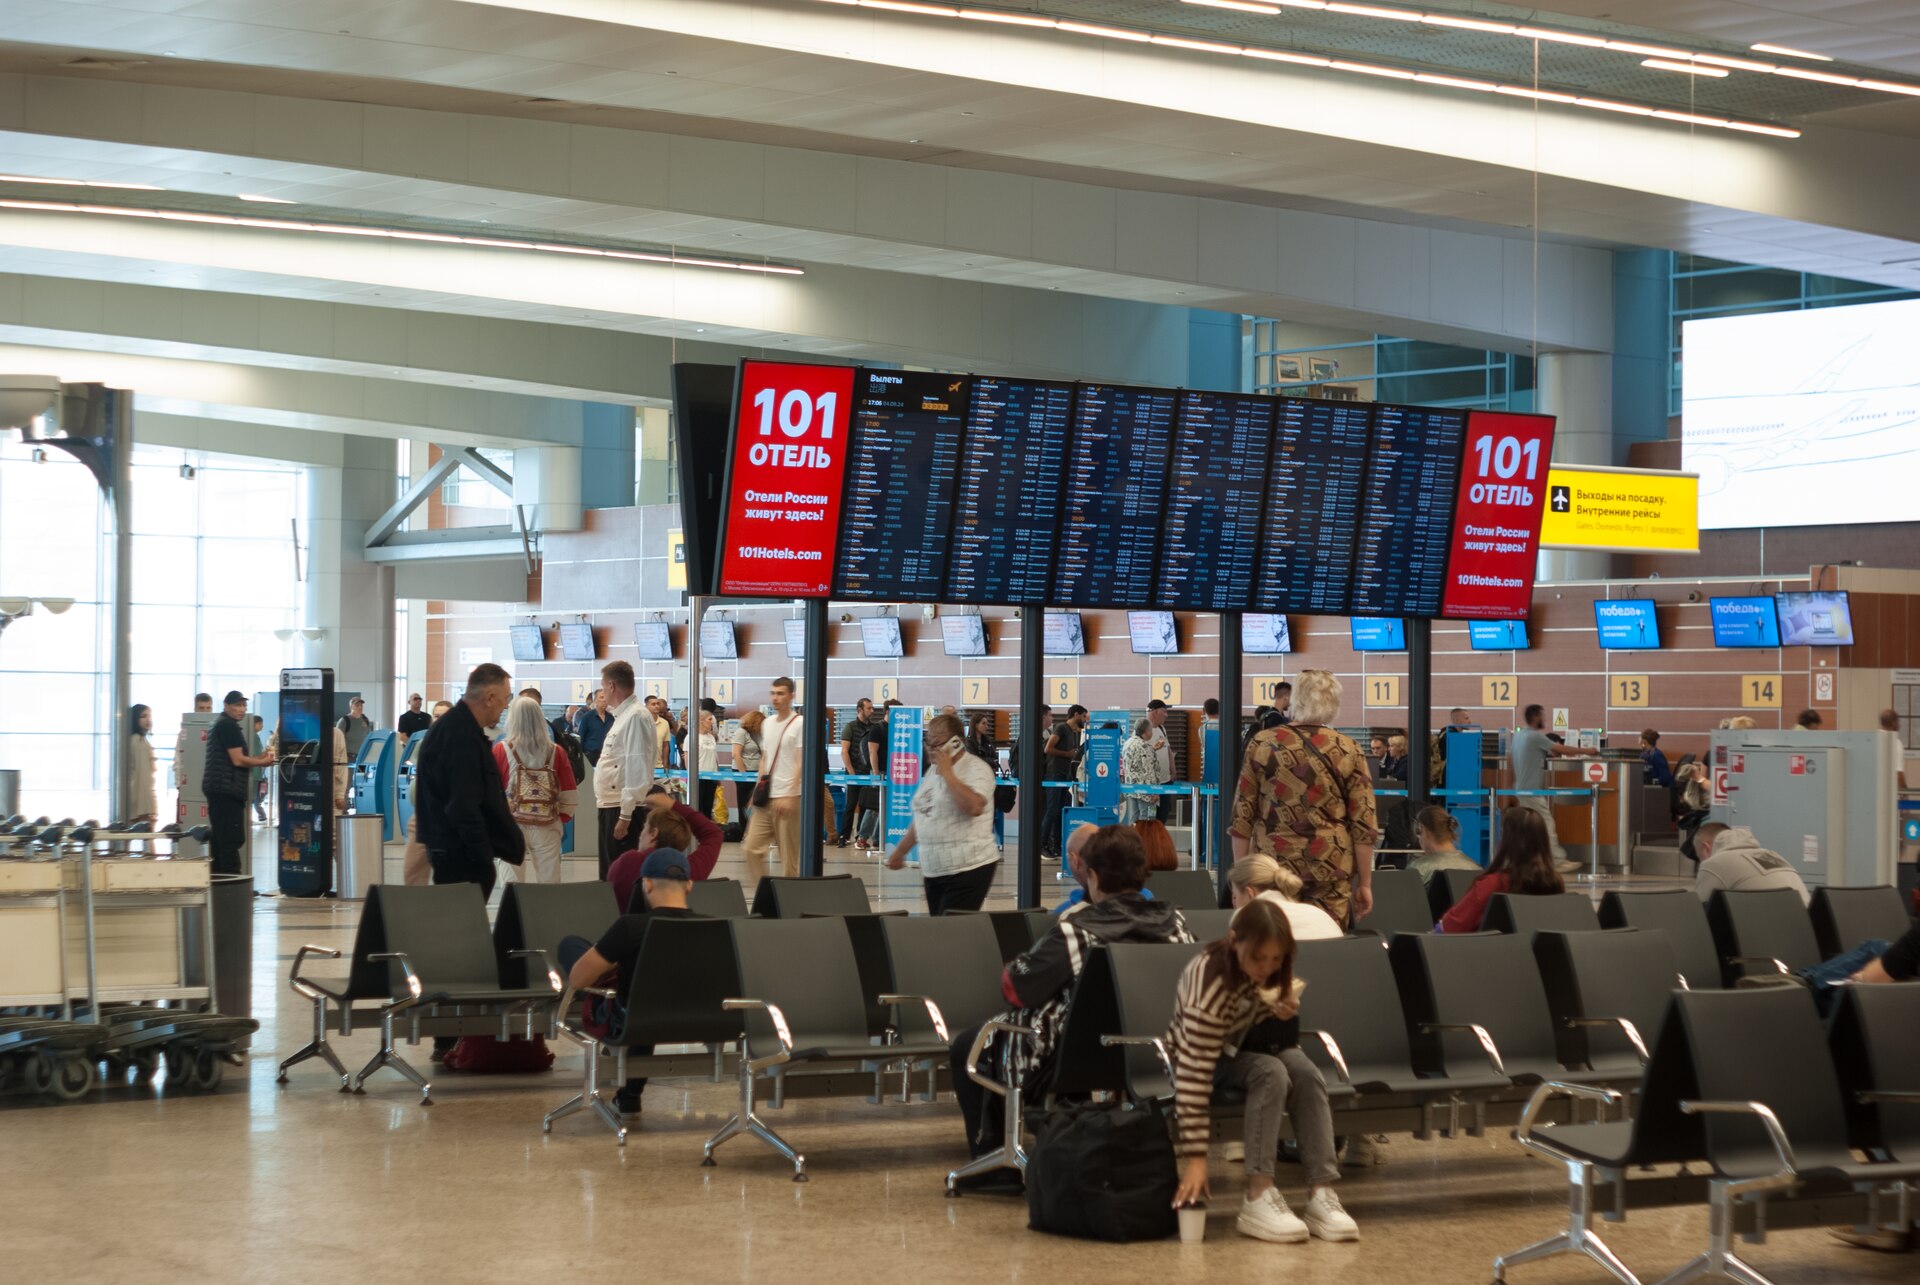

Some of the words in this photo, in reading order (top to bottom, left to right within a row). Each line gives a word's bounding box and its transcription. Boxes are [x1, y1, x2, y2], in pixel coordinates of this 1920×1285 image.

[870, 374, 903, 384] Вылеты
[754, 388, 837, 439] 101
[749, 443, 831, 468] ОТЕЛЬ
[1475, 434, 1541, 480] 101
[745, 490, 782, 503] Отели
[784, 491, 828, 505] России
[1469, 483, 1534, 506] ОТЕЛЬ
[1576, 489, 1614, 502] Выходы
[1616, 493, 1627, 502] на
[745, 508, 783, 521] живут
[785, 509, 824, 521] здесь!
[1576, 505, 1631, 518] Внутренние
[1632, 508, 1661, 520] рейсы
[1465, 524, 1494, 537] Отели
[1495, 526, 1530, 538] России
[1596, 523, 1623, 532] Domestic
[1625, 524, 1643, 534] flights
[738, 546, 822, 561] 101Hotels.com
[1464, 541, 1494, 553] живут
[1496, 542, 1526, 553] здесь!
[818, 583, 828, 592] 0+
[1457, 574, 1523, 588] 101Hotels.com
[1600, 604, 1635, 616] победа
[1716, 601, 1753, 614] победа
[578, 684, 584, 698] 2
[718, 684, 725, 699] 4
[882, 683, 889, 699] 6
[972, 683, 979, 699] 7
[1060, 682, 1068, 700] 8
[1163, 682, 1171, 699] 9
[1260, 682, 1276, 700] 10
[1374, 682, 1390, 700] 11
[1490, 681, 1510, 701] 12
[1620, 681, 1640, 701] 13
[1751, 681, 1774, 701] 14
